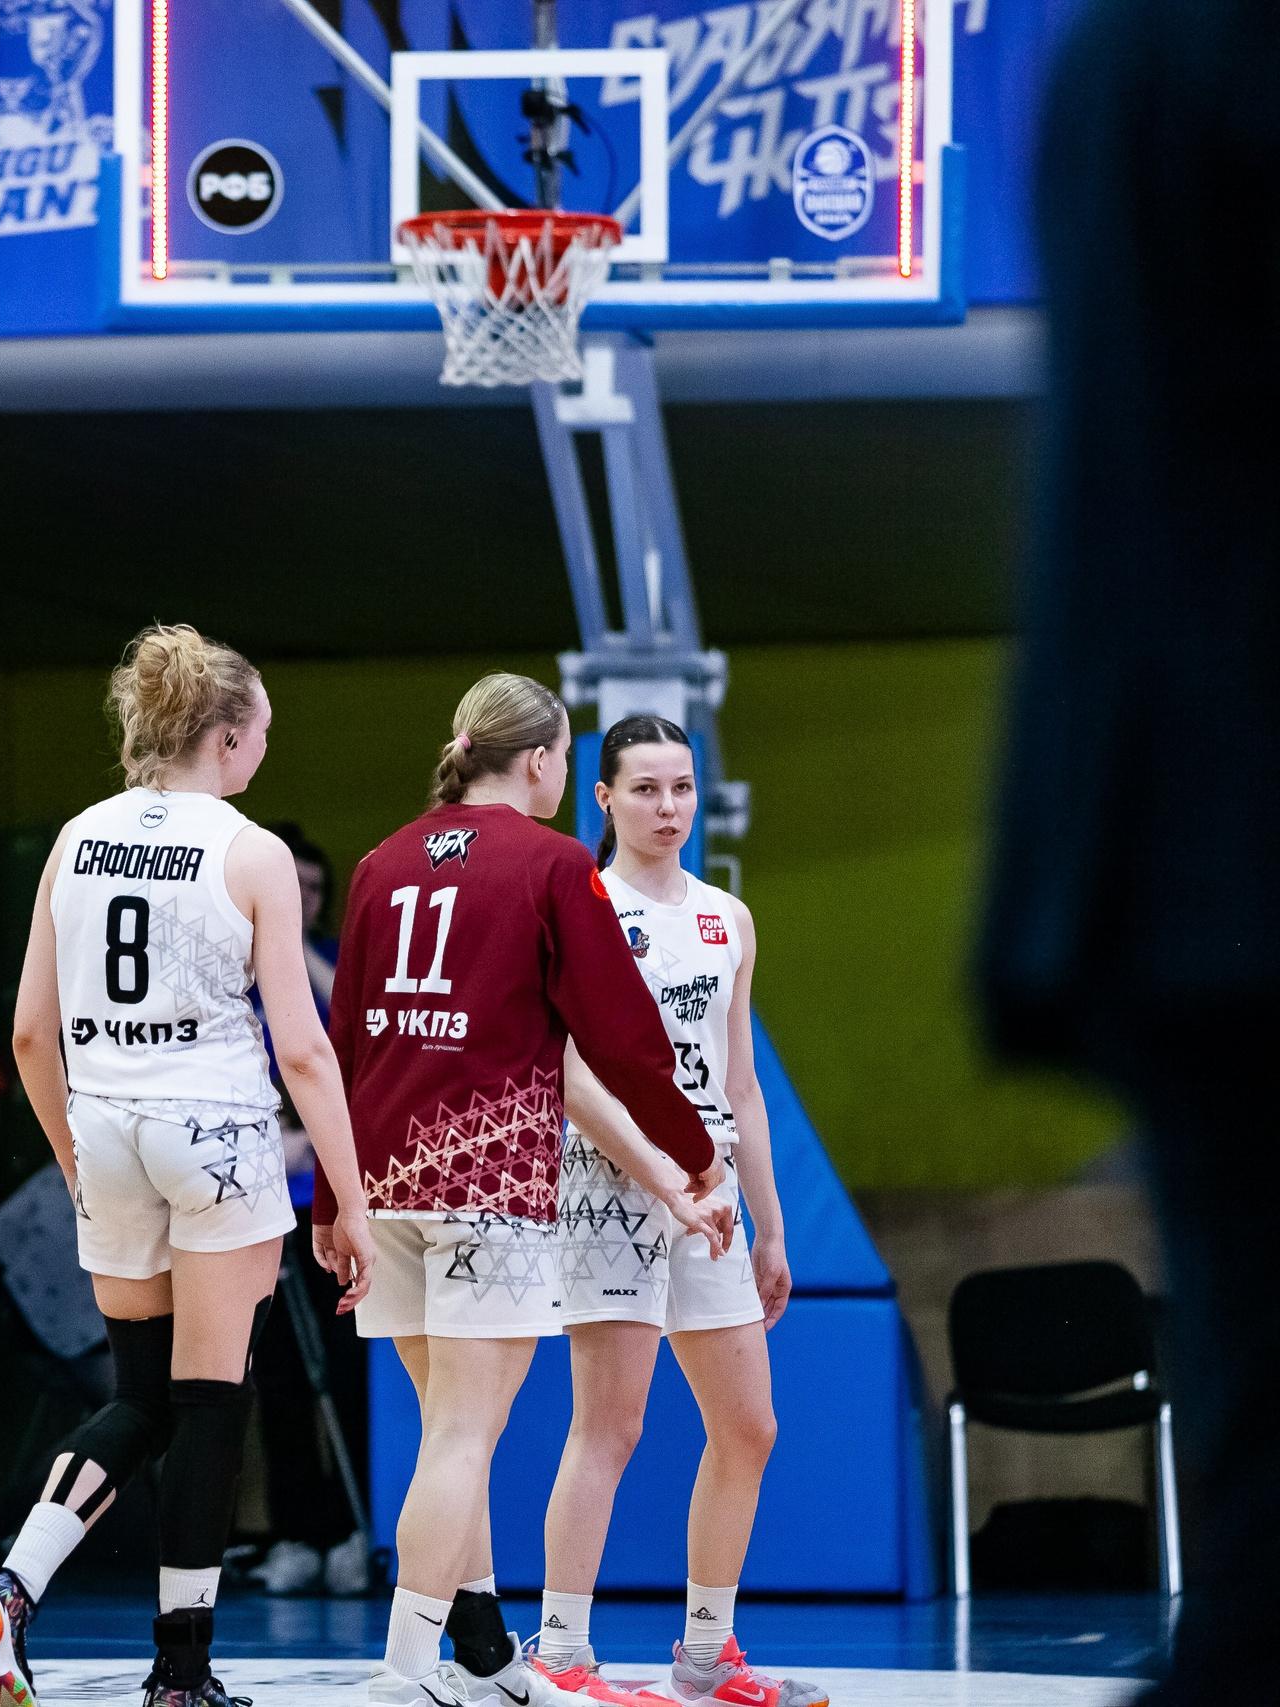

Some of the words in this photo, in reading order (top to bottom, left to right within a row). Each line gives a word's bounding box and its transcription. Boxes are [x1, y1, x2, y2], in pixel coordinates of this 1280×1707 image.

[73, 839, 205, 882] САФОНОВА
[700, 917, 723, 929] FON
[384, 885, 458, 995] 11
[702, 929, 725, 941] BET
[105, 895, 150, 1005] 8
[104, 1019, 198, 1045] ЧКПЗ
[544, 1621, 568, 1630] PEAK
[691, 1612, 718, 1621] PEAK
